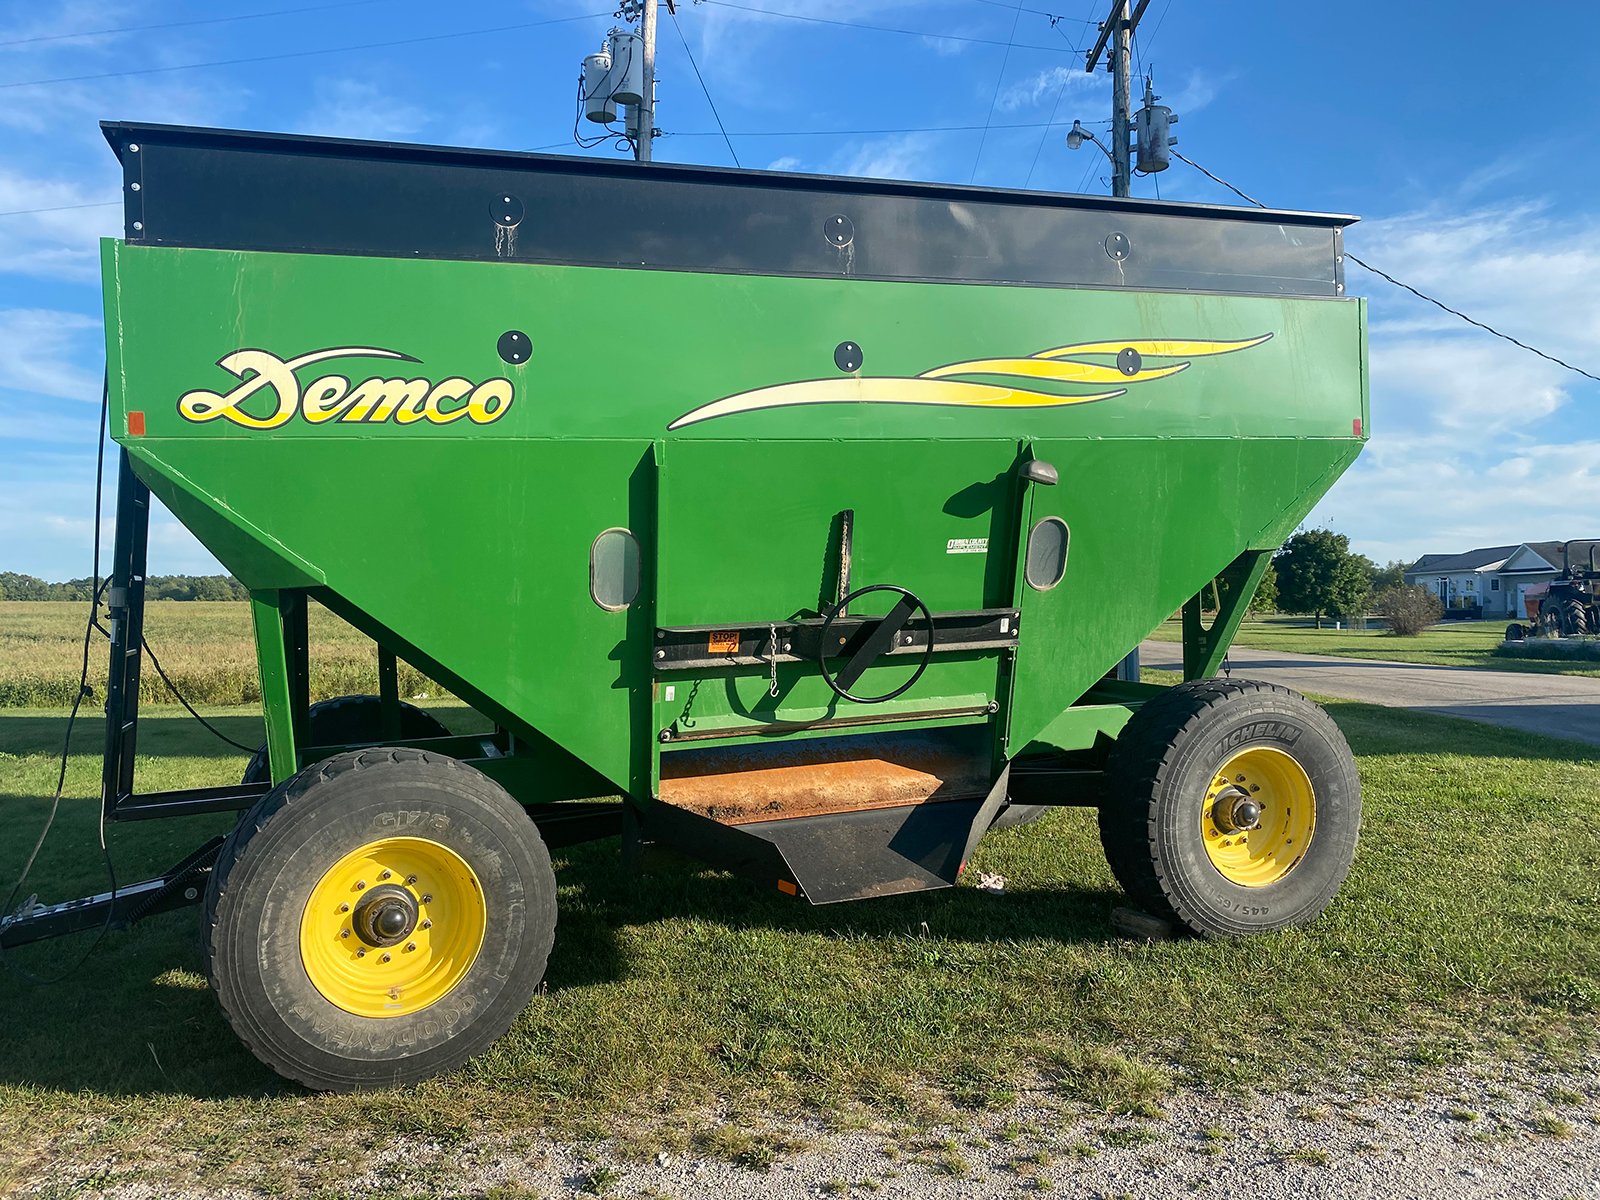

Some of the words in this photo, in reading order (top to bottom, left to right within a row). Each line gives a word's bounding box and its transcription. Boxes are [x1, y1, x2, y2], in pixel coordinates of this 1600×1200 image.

[177, 346, 515, 430] Demco
[712, 632, 737, 640] STOP!
[1207, 722, 1301, 767] MICHELIN
[292, 993, 478, 1052] GOODYEAR
